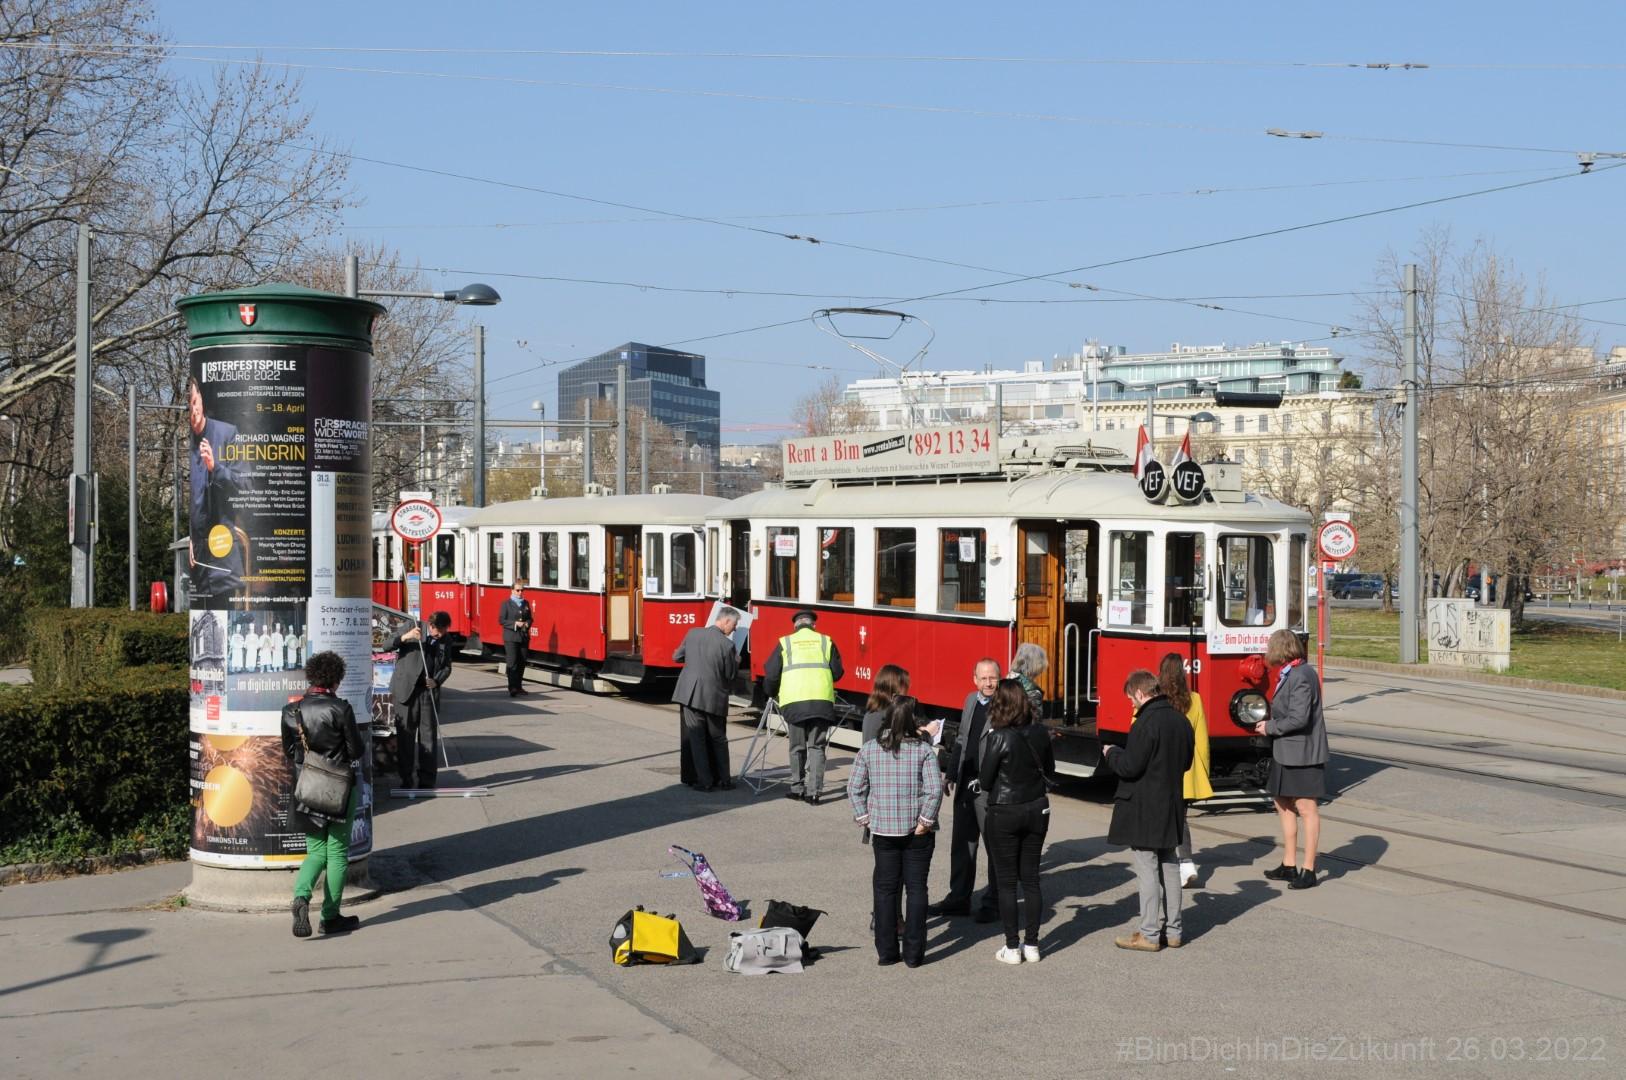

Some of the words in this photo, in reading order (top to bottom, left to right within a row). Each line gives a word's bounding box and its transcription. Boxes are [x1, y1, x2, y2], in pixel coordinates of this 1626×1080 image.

[207, 360, 296, 371] OSTERFESTSPIELE
[207, 370, 250, 382] SALZBURG
[254, 370, 281, 380] 2022
[286, 403, 305, 413] April
[314, 417, 369, 431] FÜRSPRACHE
[235, 433, 269, 442] RICHARD
[271, 433, 305, 442] WAGNER
[787, 442, 816, 464] Rent
[820, 447, 828, 462] a
[833, 439, 860, 461] Bim
[915, 431, 941, 456] 892
[948, 430, 964, 454] 13
[971, 428, 990, 453] 34
[218, 444, 305, 461] LOHENGRIN
[1176, 470, 1202, 491] VEF
[273, 528, 305, 536] KONZERTE
[435, 591, 454, 599] 5419
[669, 613, 696, 624] 5235
[1225, 634, 1237, 644] Bim
[1237, 633, 1252, 644] Dich
[1253, 634, 1259, 644] in
[855, 667, 871, 681] 4149
[237, 679, 247, 691] im
[247, 678, 280, 693] digitalen
[282, 678, 310, 691] Museu
[206, 835, 248, 845] TONKÜNSTLER
